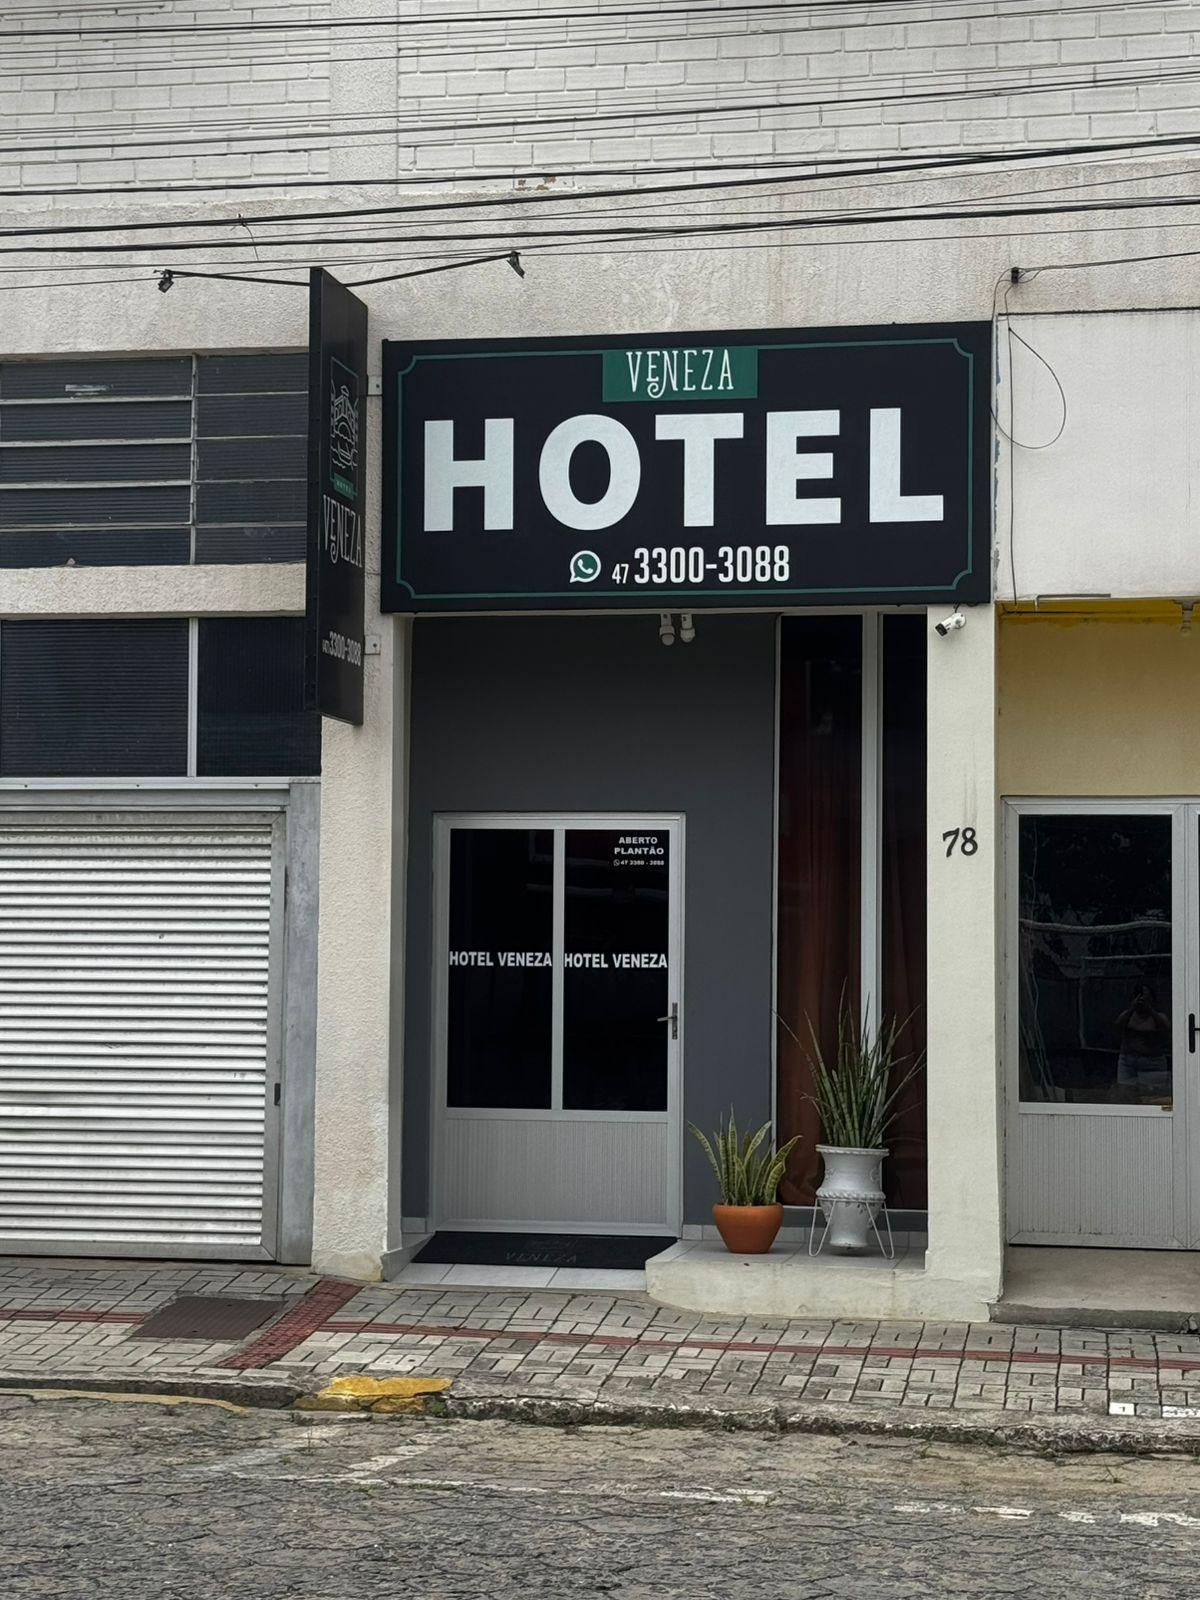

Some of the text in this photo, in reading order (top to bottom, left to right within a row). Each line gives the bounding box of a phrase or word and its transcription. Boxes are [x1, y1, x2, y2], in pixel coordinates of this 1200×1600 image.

[626, 349, 734, 399] VENEZA
[423, 407, 945, 532] HOTEL
[323, 494, 362, 568] VENEZA
[612, 545, 790, 584] 47 3300-3088
[614, 846, 665, 855] PLANTÃO
[618, 836, 658, 844] ABERTO
[942, 827, 978, 857] 78
[449, 951, 552, 967] HOTEL VENEZA
[564, 953, 668, 969] HOTEL VENEZA
